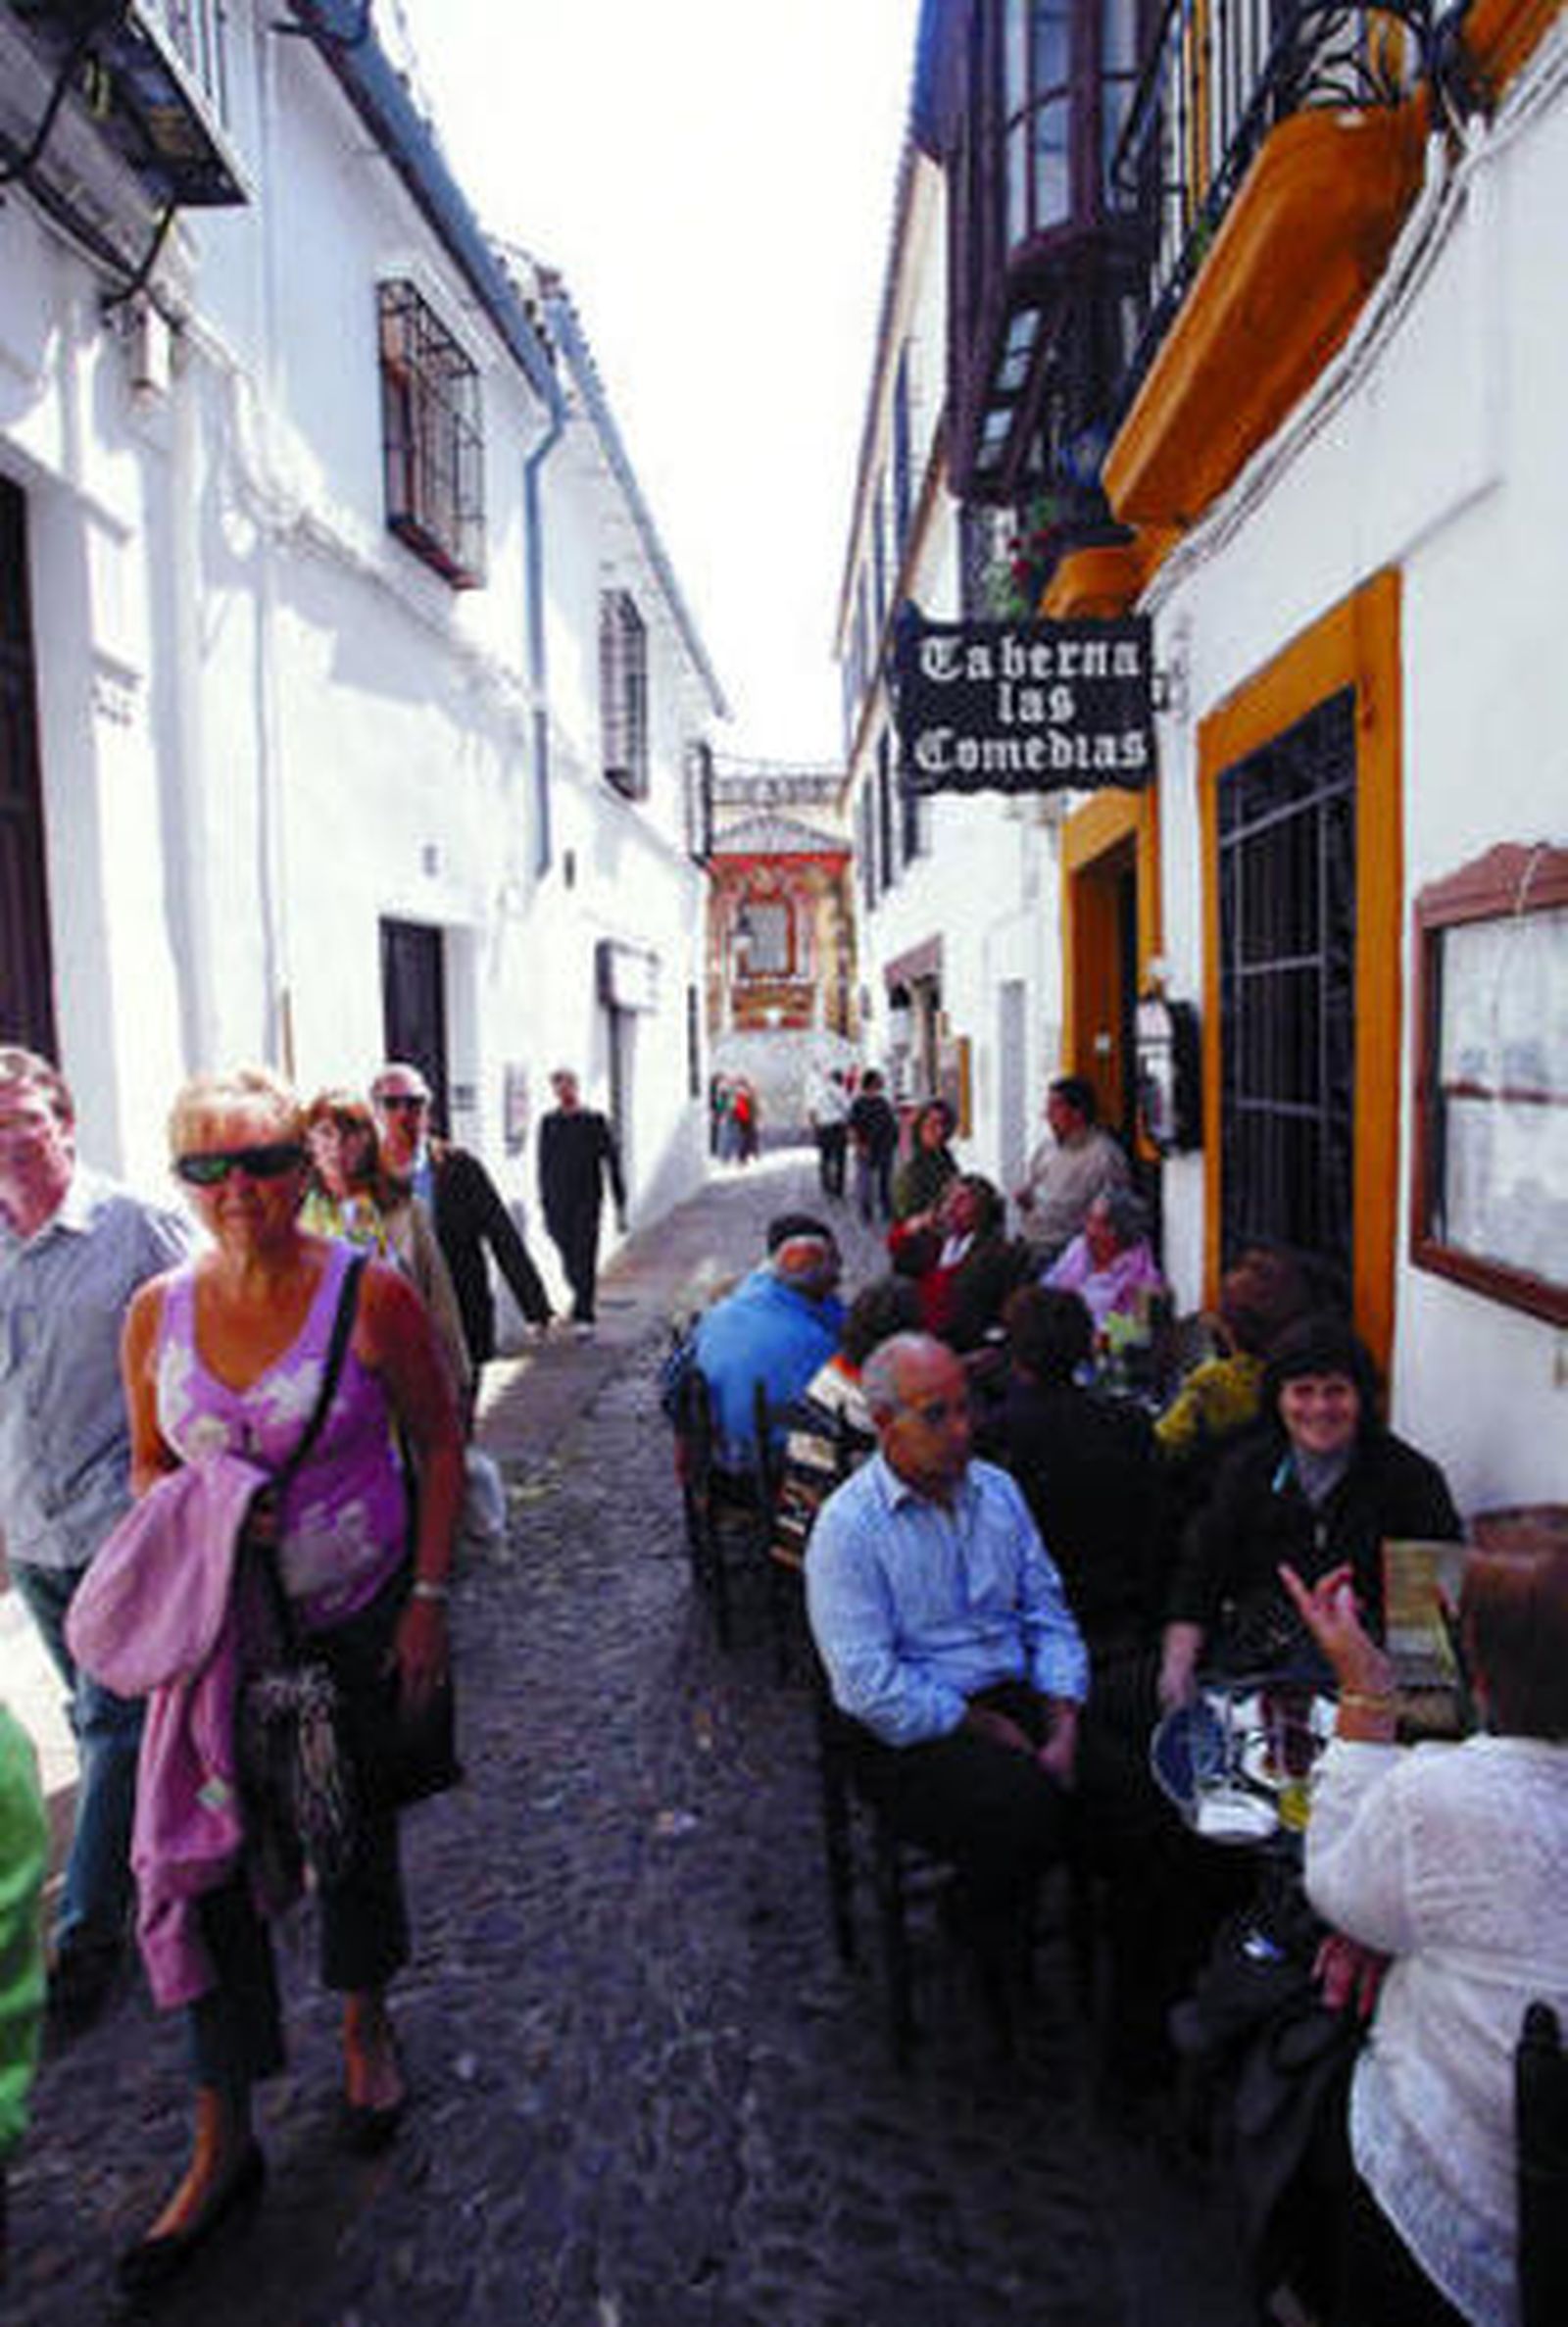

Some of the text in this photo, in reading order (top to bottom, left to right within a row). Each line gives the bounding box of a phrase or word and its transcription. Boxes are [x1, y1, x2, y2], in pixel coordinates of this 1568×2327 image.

[919, 637, 1141, 681] Taberna
[998, 682, 1076, 723] las
[913, 728, 1148, 773] Comedias
